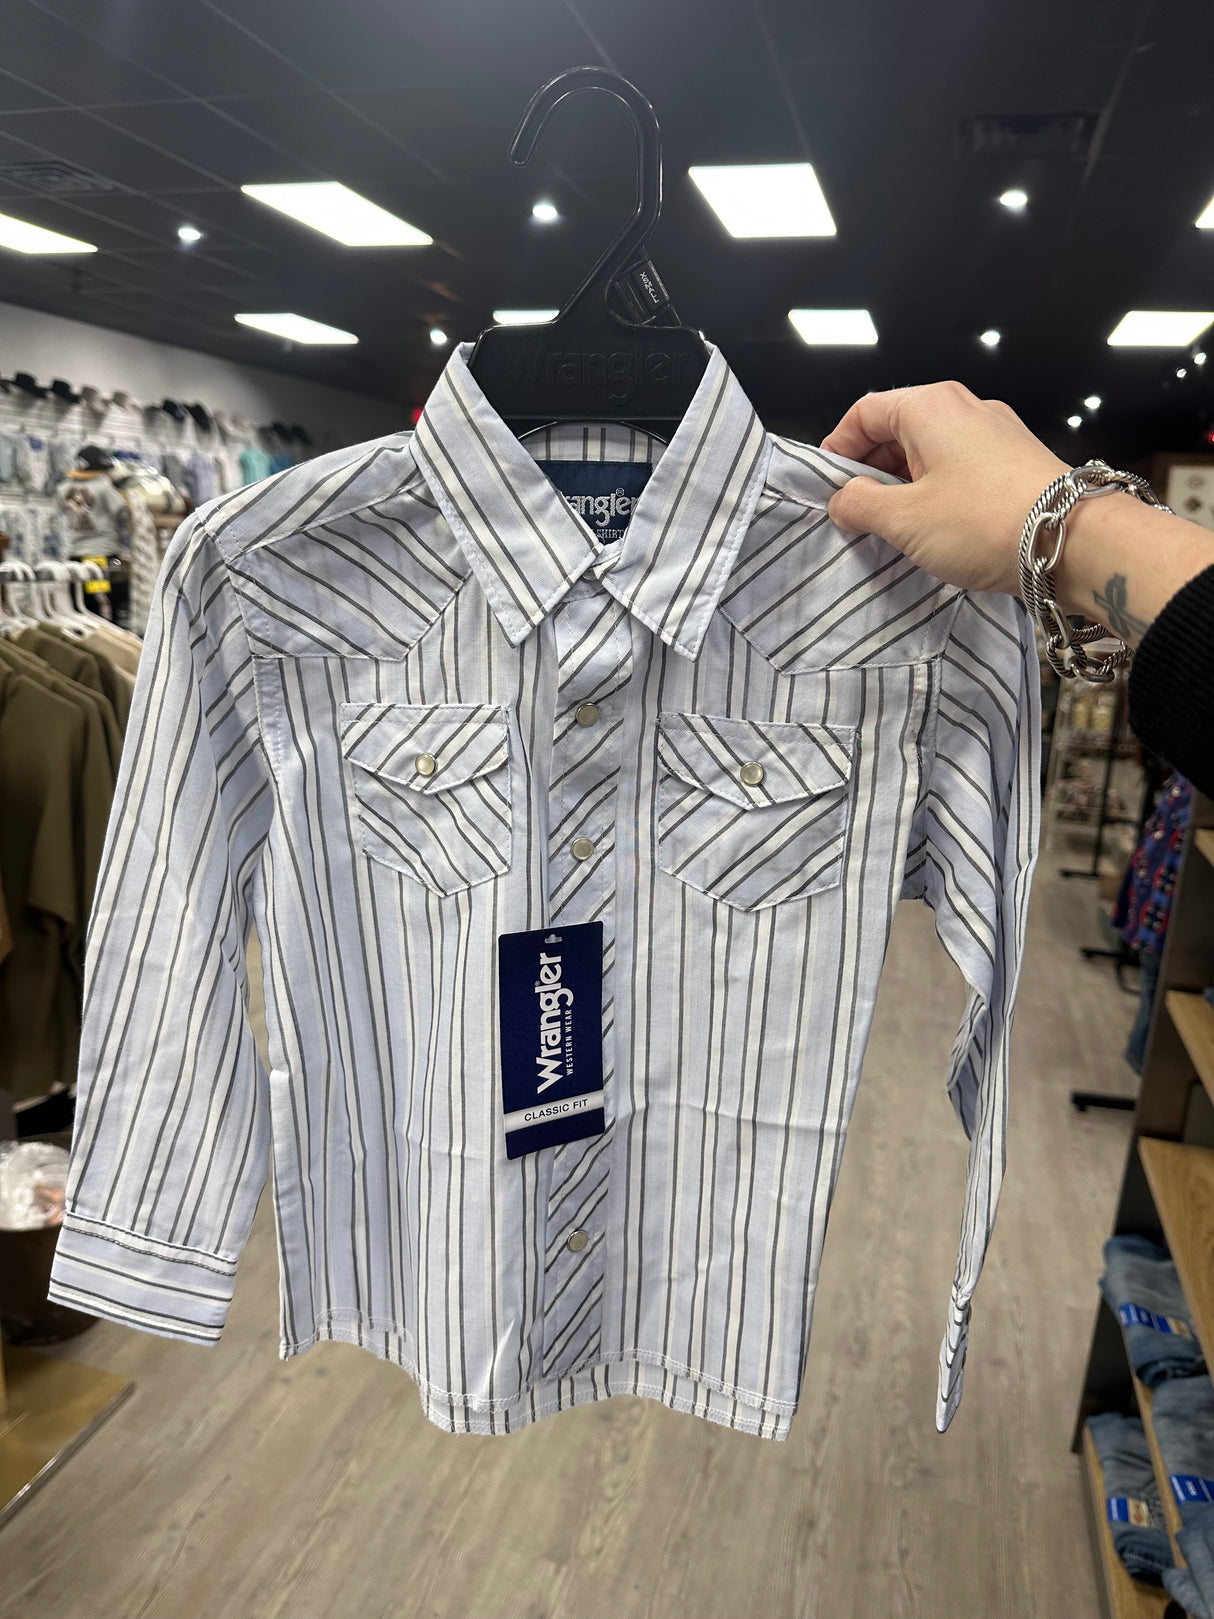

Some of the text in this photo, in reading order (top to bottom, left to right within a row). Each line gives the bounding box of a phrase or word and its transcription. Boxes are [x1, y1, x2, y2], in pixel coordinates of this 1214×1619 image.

[505, 343, 689, 406] Wrangler
[566, 493, 640, 527] angler
[535, 952, 574, 1094] Wrangler
[564, 1009, 574, 1076] WESTERN WEAR
[524, 1098, 589, 1122] CLASSIC FIT
